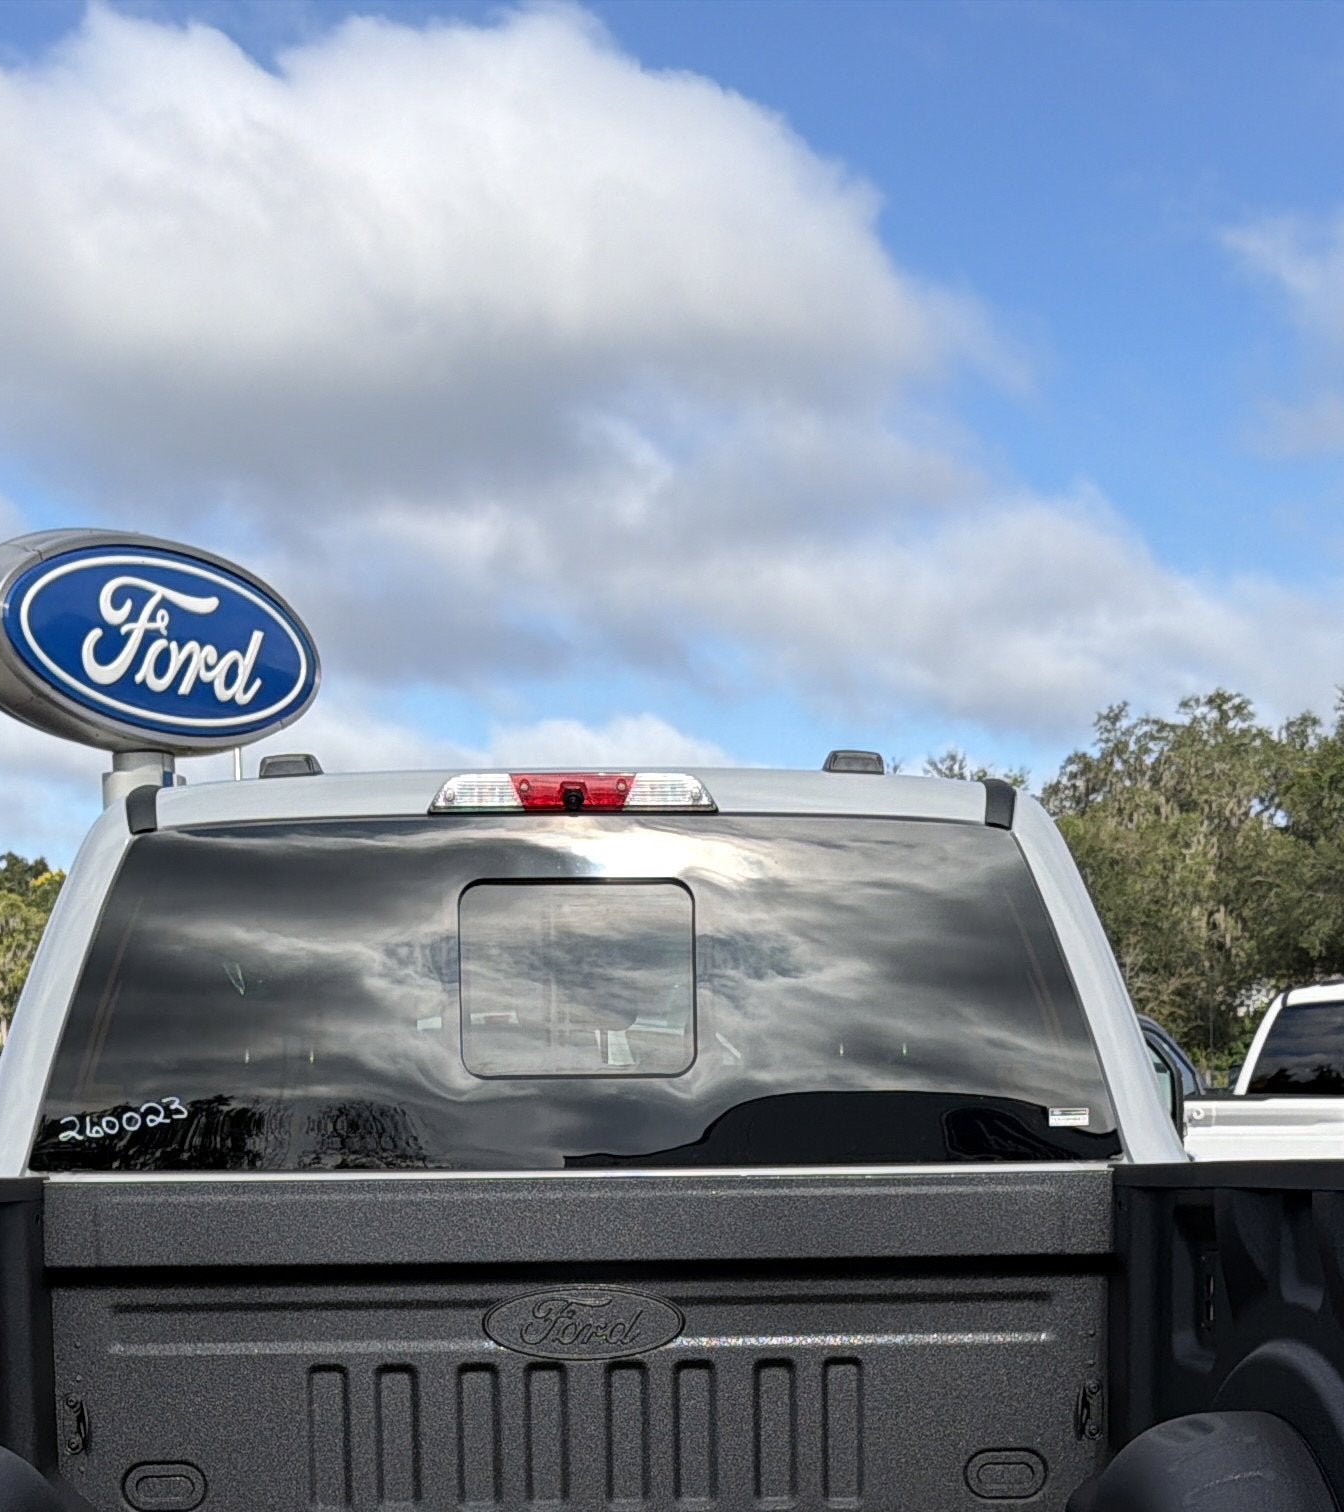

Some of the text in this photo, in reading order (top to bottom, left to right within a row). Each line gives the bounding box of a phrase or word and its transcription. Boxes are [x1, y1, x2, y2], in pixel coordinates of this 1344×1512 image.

[81, 575, 265, 706] Ford
[57, 1095, 189, 1142] 260023
[519, 1293, 644, 1346] Ford
